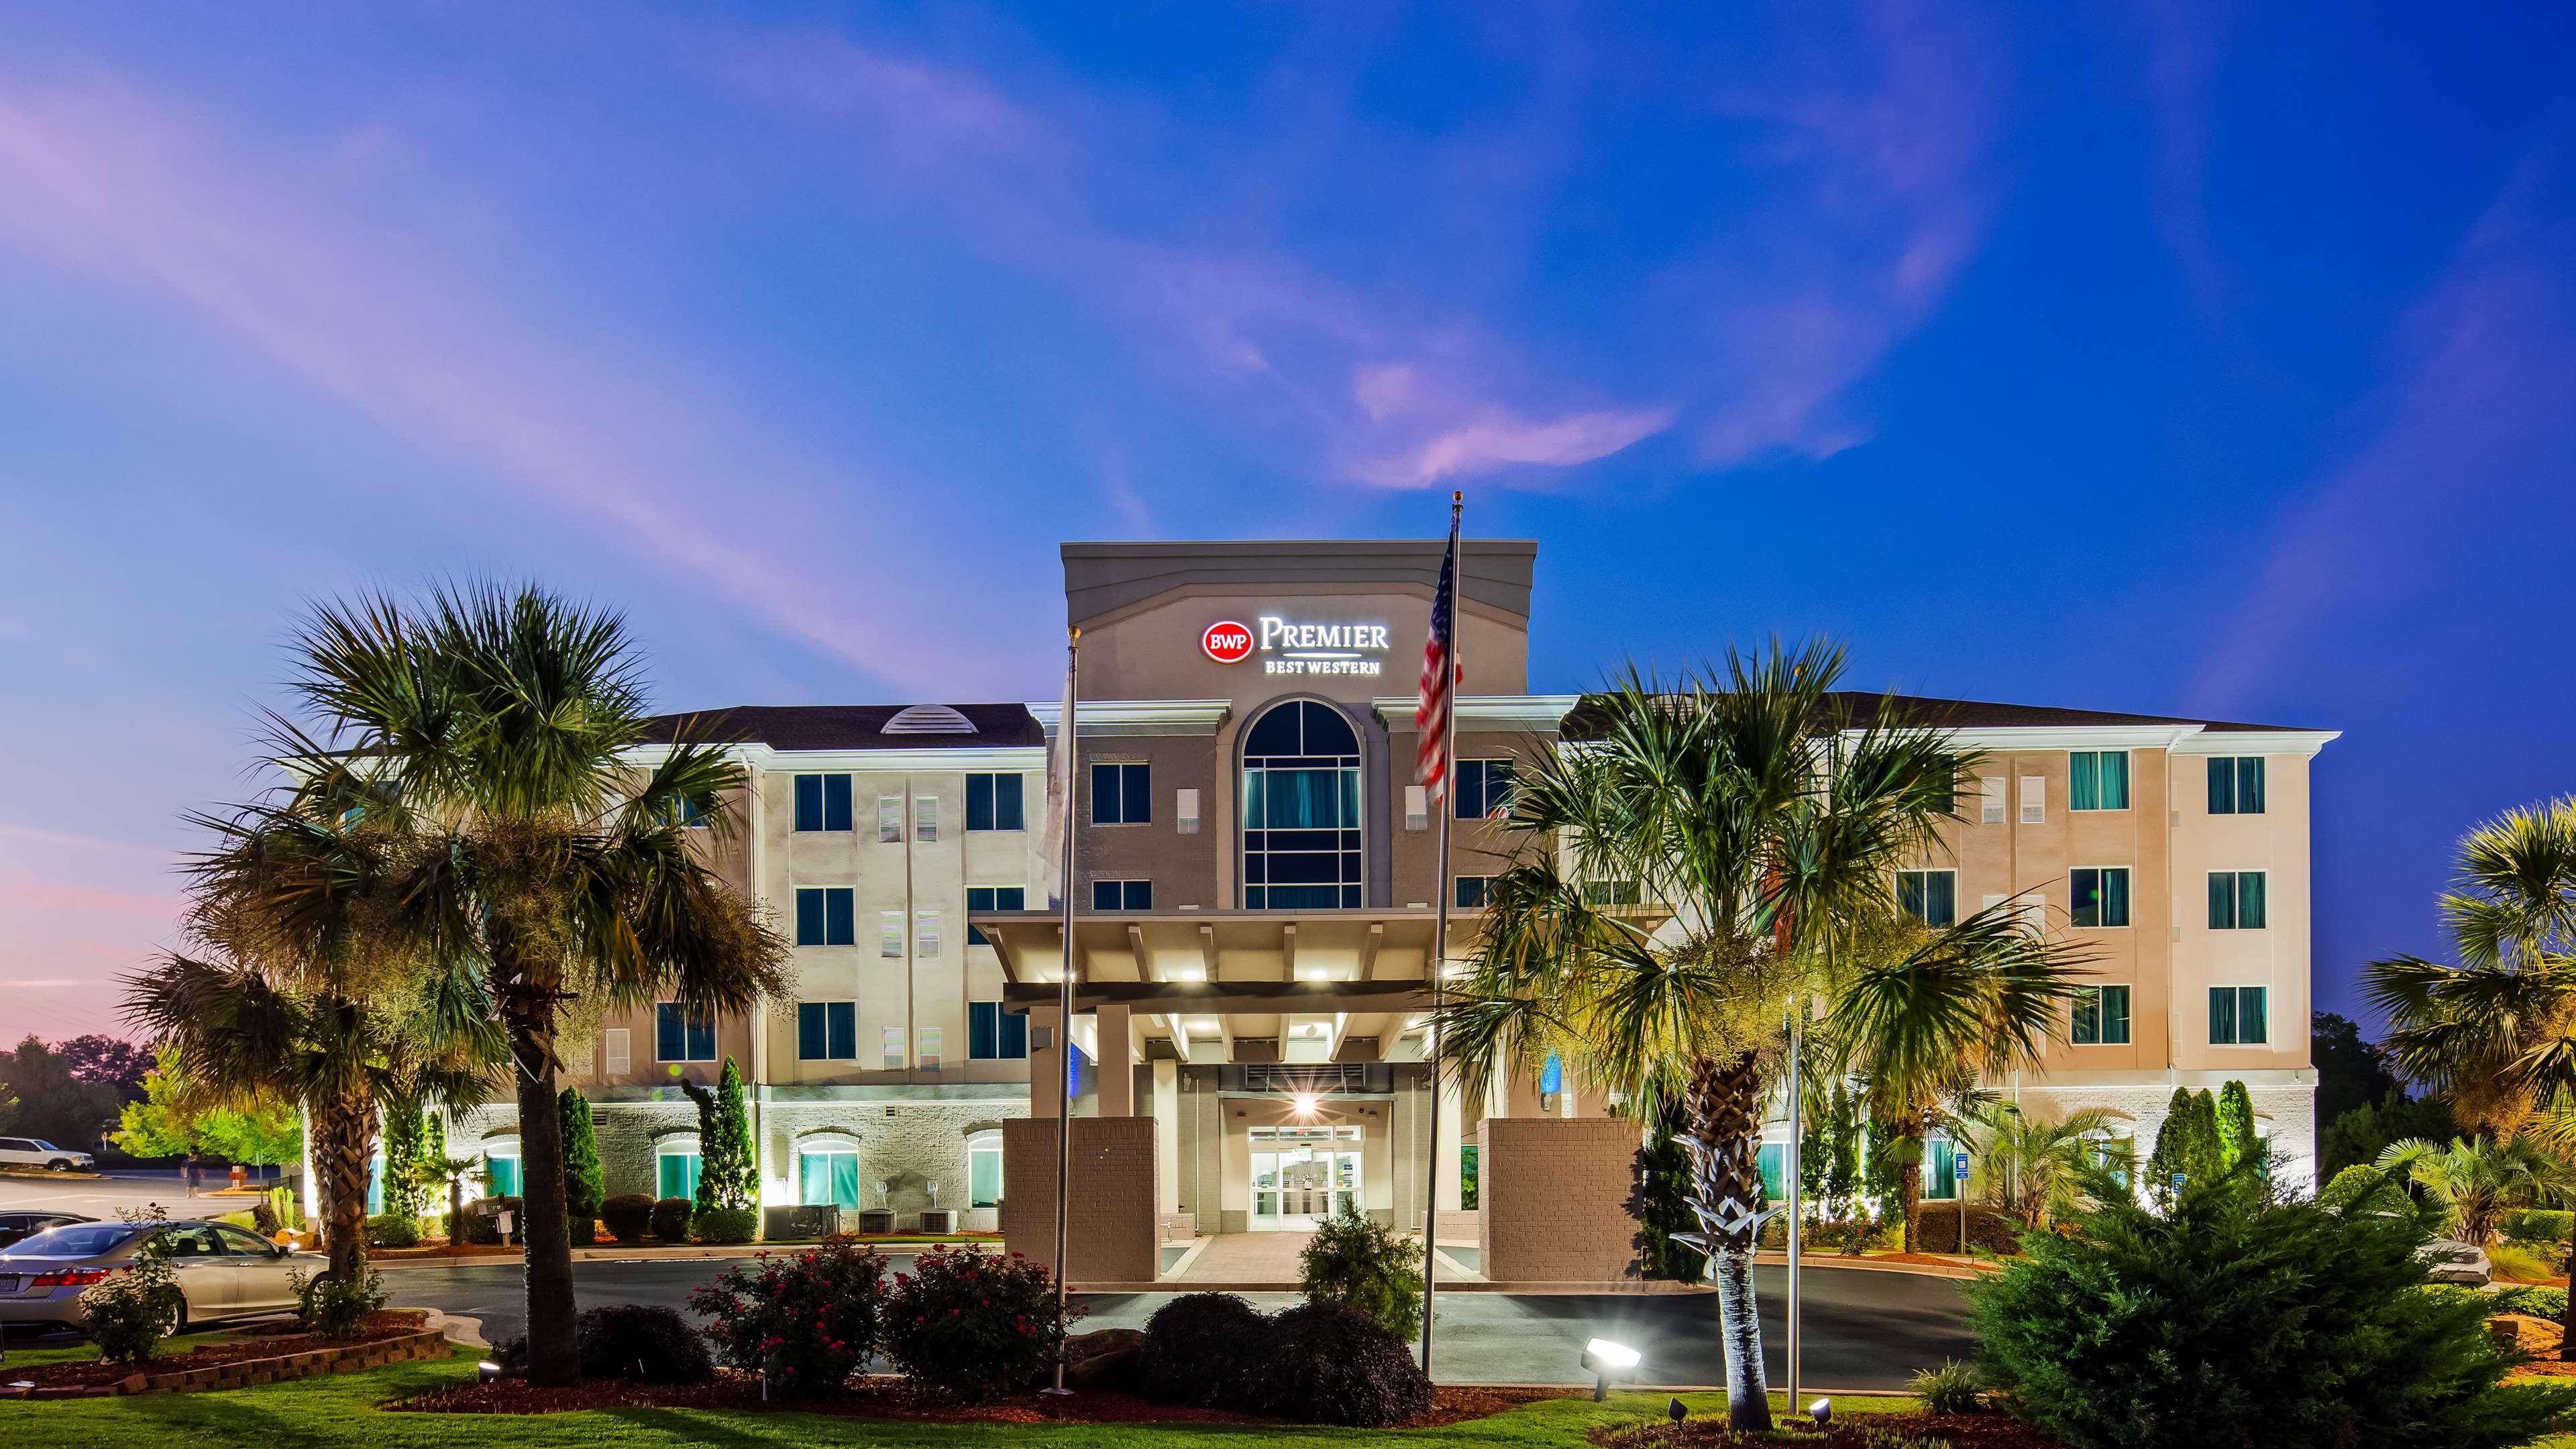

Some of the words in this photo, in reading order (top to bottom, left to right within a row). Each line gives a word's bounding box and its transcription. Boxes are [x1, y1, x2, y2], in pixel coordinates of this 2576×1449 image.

[1258, 616, 1389, 649] PREMIER
[1210, 634, 1247, 649] BWP
[1266, 661, 1305, 674] BEST
[1307, 661, 1380, 674] WESTERN
